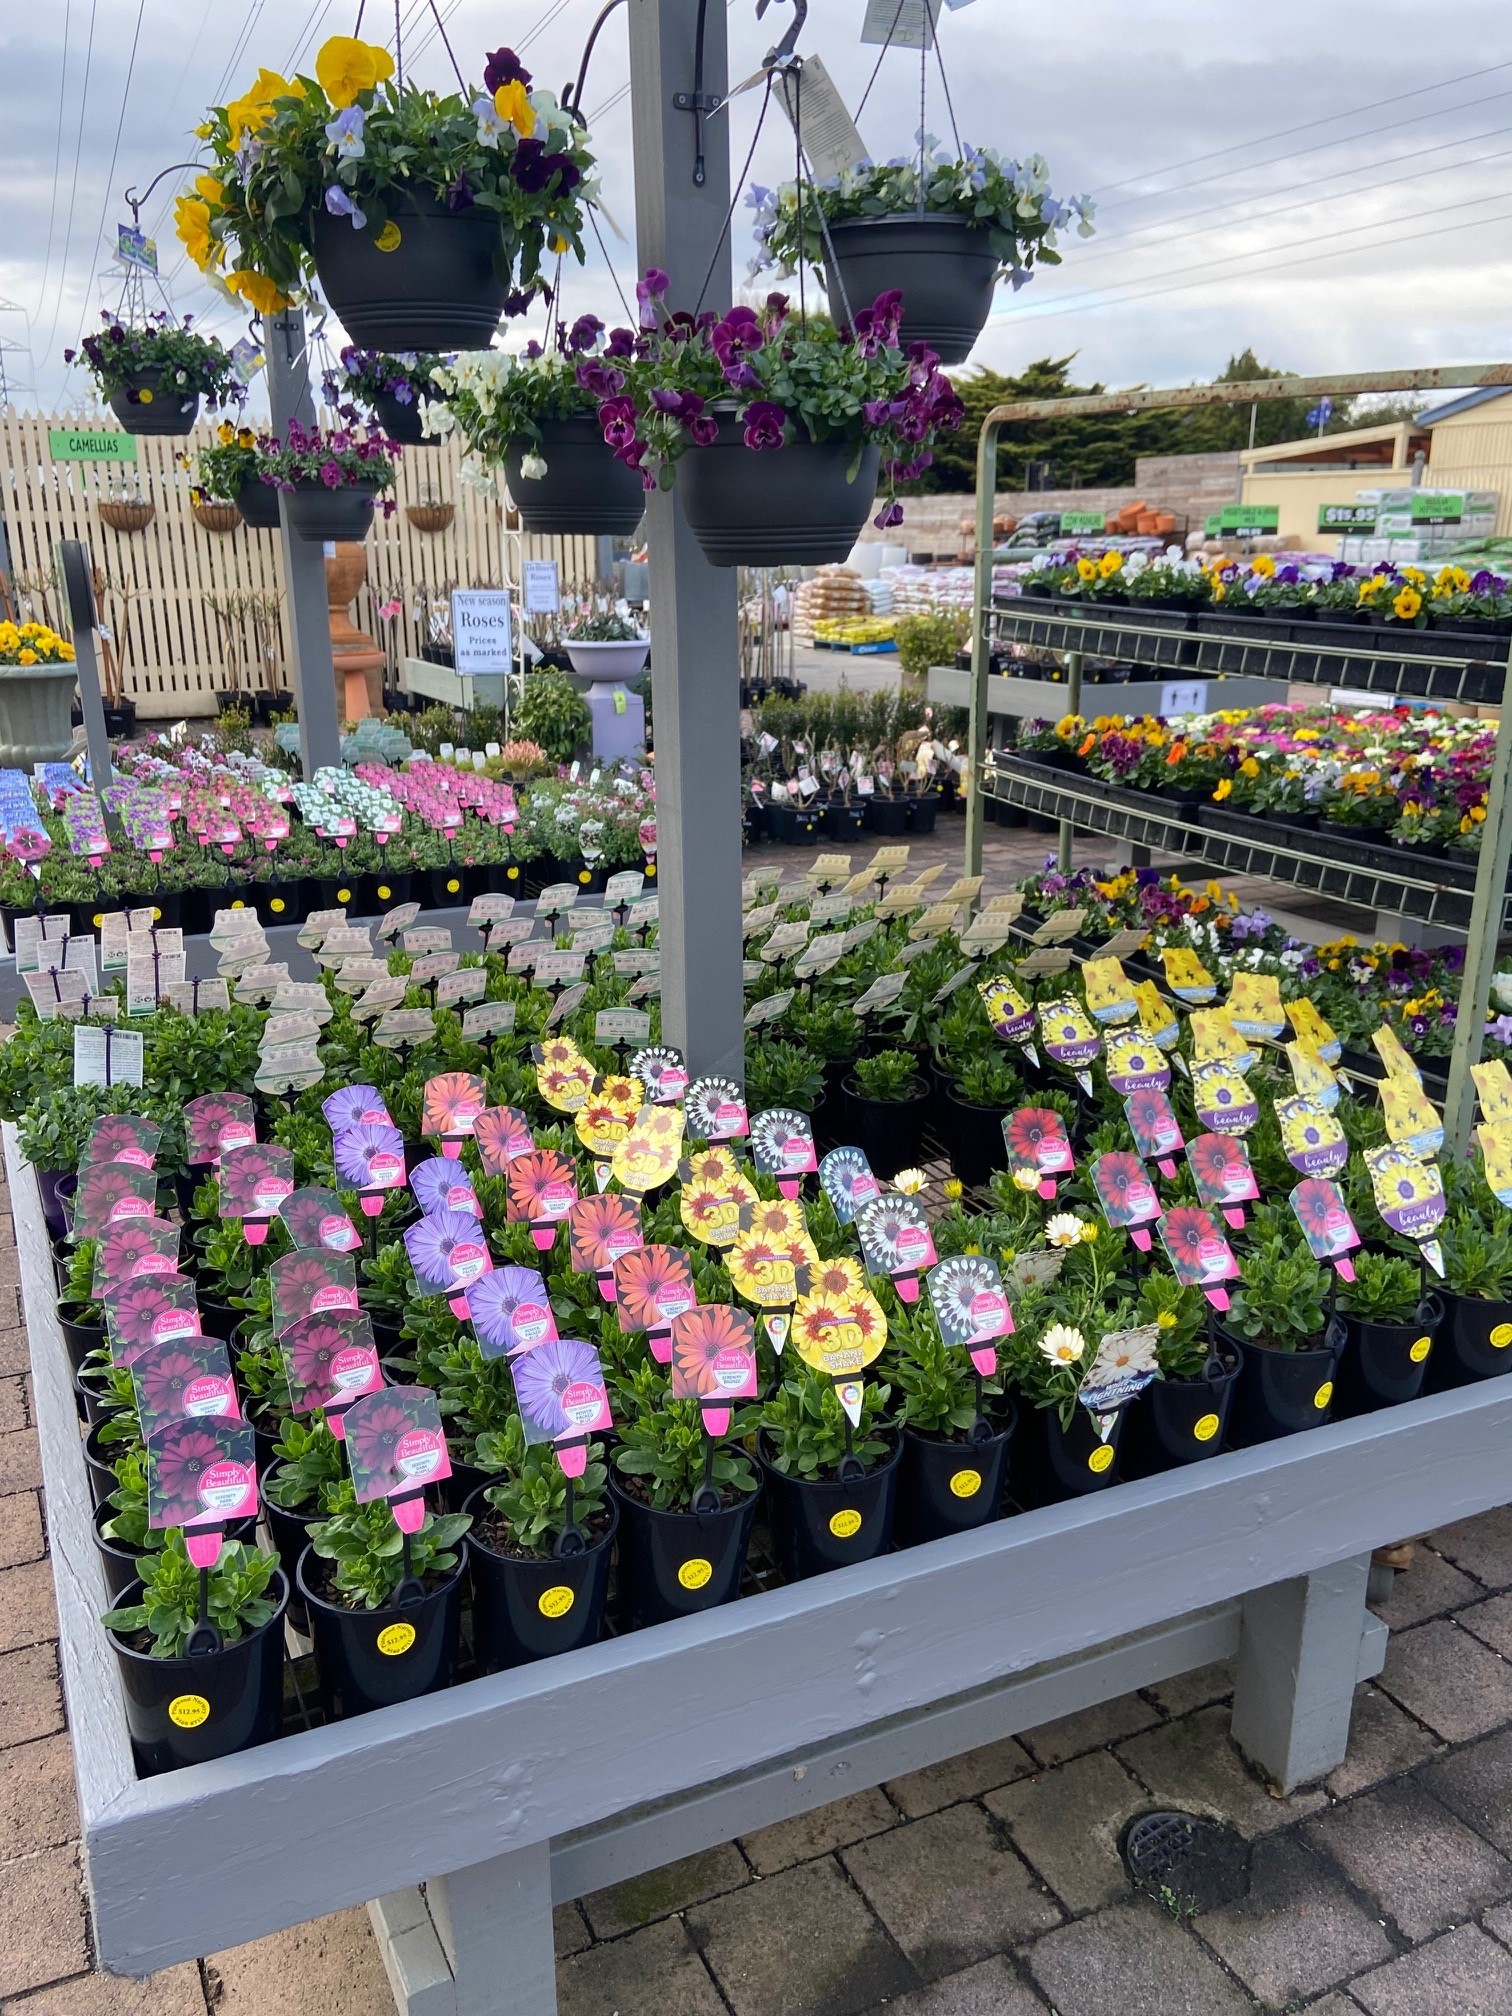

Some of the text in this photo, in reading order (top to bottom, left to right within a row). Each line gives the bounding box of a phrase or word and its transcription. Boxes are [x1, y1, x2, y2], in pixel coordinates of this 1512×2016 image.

[69, 438, 119, 453] CAMELLIAS
[457, 594, 506, 606] New season
[461, 612, 504, 628] Roses
[469, 636, 497, 645] Prices
[473, 647, 507, 656] marked
[1005, 1018, 1033, 1034] beauty
[1060, 1045, 1096, 1057] beauty
[556, 1078, 586, 1099] 3D
[1124, 1077, 1165, 1090] beauty
[1213, 1113, 1253, 1126] beauty
[593, 1119, 629, 1140] 3D
[631, 1152, 662, 1175] 3D
[1304, 1152, 1343, 1169] beauty
[120, 1201, 143, 1211] Simply
[702, 1201, 740, 1228] 3D
[1398, 1206, 1440, 1226] beauty
[709, 1224, 739, 1237] BANAN
[716, 1231, 739, 1241] SHAK
[609, 1239, 637, 1247] Beautiful
[611, 1234, 633, 1242] Simply
[453, 1247, 476, 1258] Simply
[142, 1259, 165, 1268] Simply
[453, 1254, 482, 1264] Beautiful
[753, 1260, 795, 1285] 3D
[320, 1290, 344, 1300] Simply
[660, 1286, 684, 1296] Simply
[755, 1285, 796, 1294] BANANA
[317, 1296, 349, 1307] Beautiful
[658, 1294, 688, 1302] Beautiful
[760, 1292, 793, 1300] SHAKE
[160, 1313, 187, 1324] Simply
[517, 1307, 540, 1318] Simply
[157, 1319, 192, 1332] Beautiful
[515, 1314, 545, 1325] Beautiful
[817, 1322, 864, 1352] 3D
[338, 1351, 365, 1365] Simply
[719, 1353, 745, 1363] Simply
[822, 1349, 865, 1362] BANANA
[335, 1357, 371, 1372] Beautiful
[716, 1360, 747, 1369] Beautiful
[829, 1357, 862, 1370] SHAKE
[192, 1380, 219, 1393] Simply
[1087, 1382, 1144, 1402] LIGHTNING
[189, 1388, 226, 1402] Beautiful
[567, 1387, 593, 1399] Simply
[566, 1394, 599, 1406] Beautiful
[575, 1408, 592, 1416] POWER
[402, 1434, 431, 1449] Simply
[400, 1441, 437, 1458] Beautiful
[209, 1466, 240, 1479] Simply
[205, 1474, 246, 1488] Beautiful
[387, 1633, 407, 1645] $12.95
